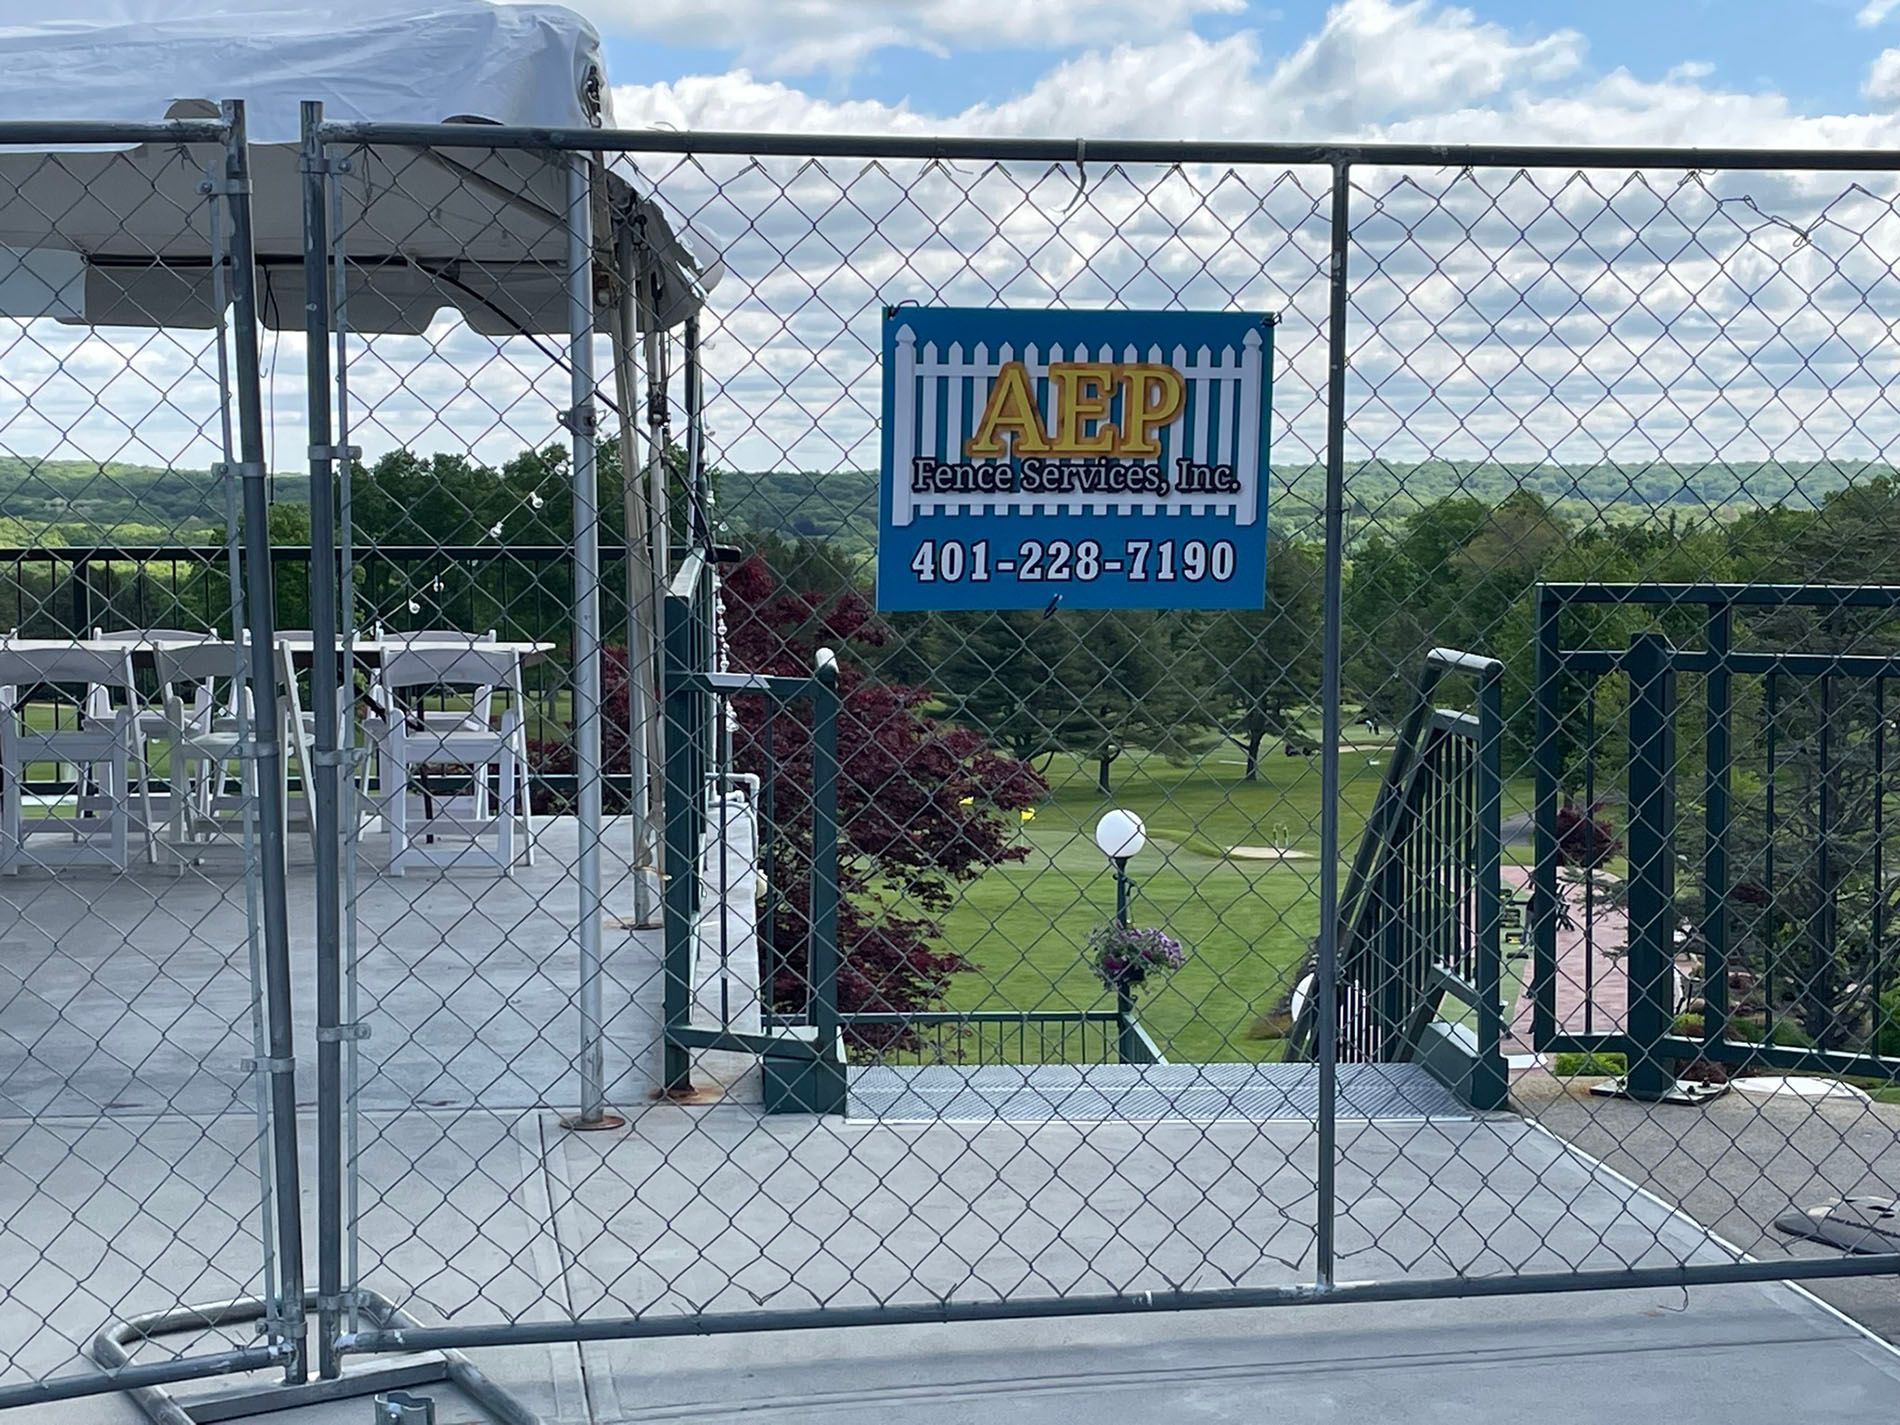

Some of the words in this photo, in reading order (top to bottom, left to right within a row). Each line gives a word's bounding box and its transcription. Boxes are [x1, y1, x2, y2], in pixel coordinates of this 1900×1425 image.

[967, 362, 1185, 457] AEP
[913, 457, 1012, 493] Fence
[1020, 457, 1168, 496] Services,
[1175, 459, 1240, 493] Inc.
[911, 539, 1235, 582] 401-228-7190
